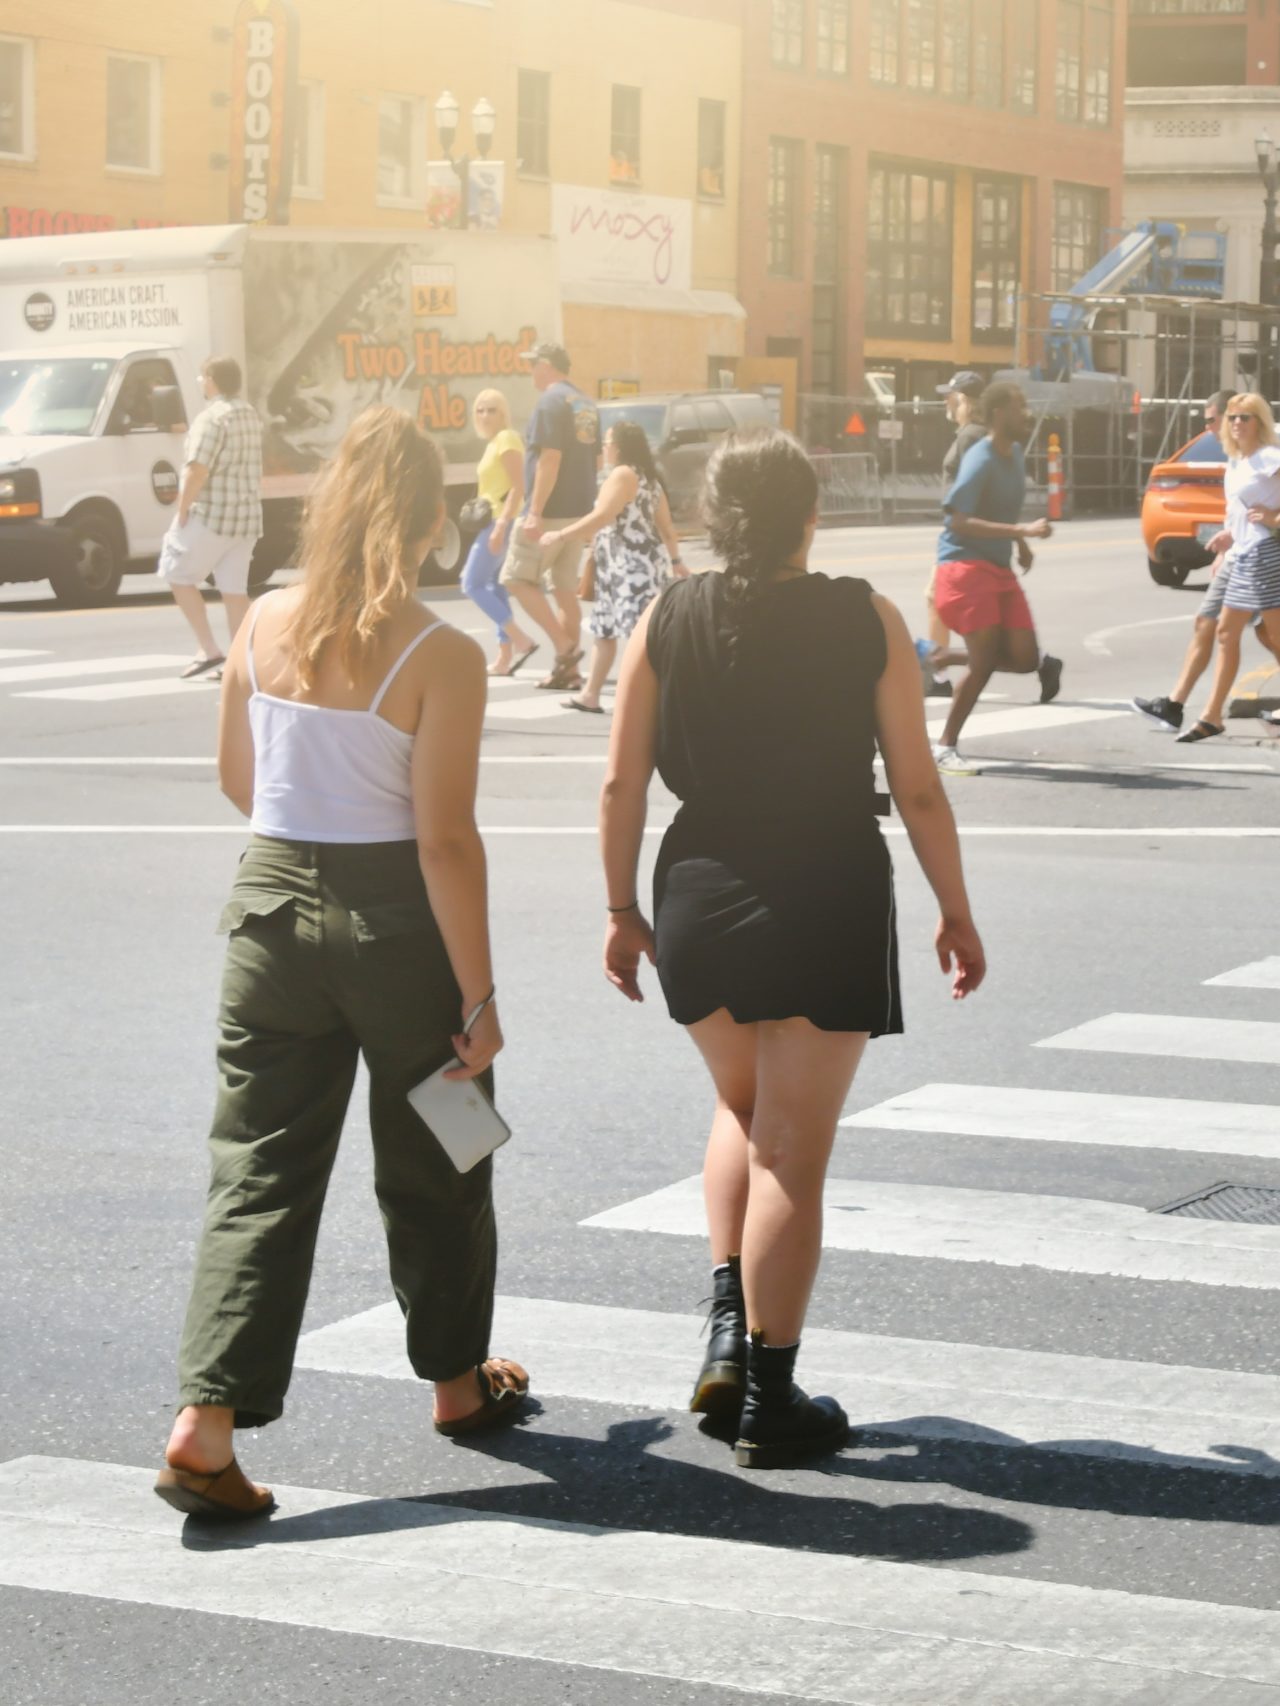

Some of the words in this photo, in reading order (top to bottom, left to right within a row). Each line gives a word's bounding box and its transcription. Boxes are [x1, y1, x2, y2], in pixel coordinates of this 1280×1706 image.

[243, 21, 273, 220] BOOTS
[67, 287, 125, 307] AMERICAN
[129, 284, 168, 304] CRAFT.
[68, 310, 126, 331] AMERICAN
[131, 307, 182, 328] PASSION.
[336, 332, 407, 380] Two
[412, 325, 537, 376] Hearted
[417, 383, 467, 430] Ale
